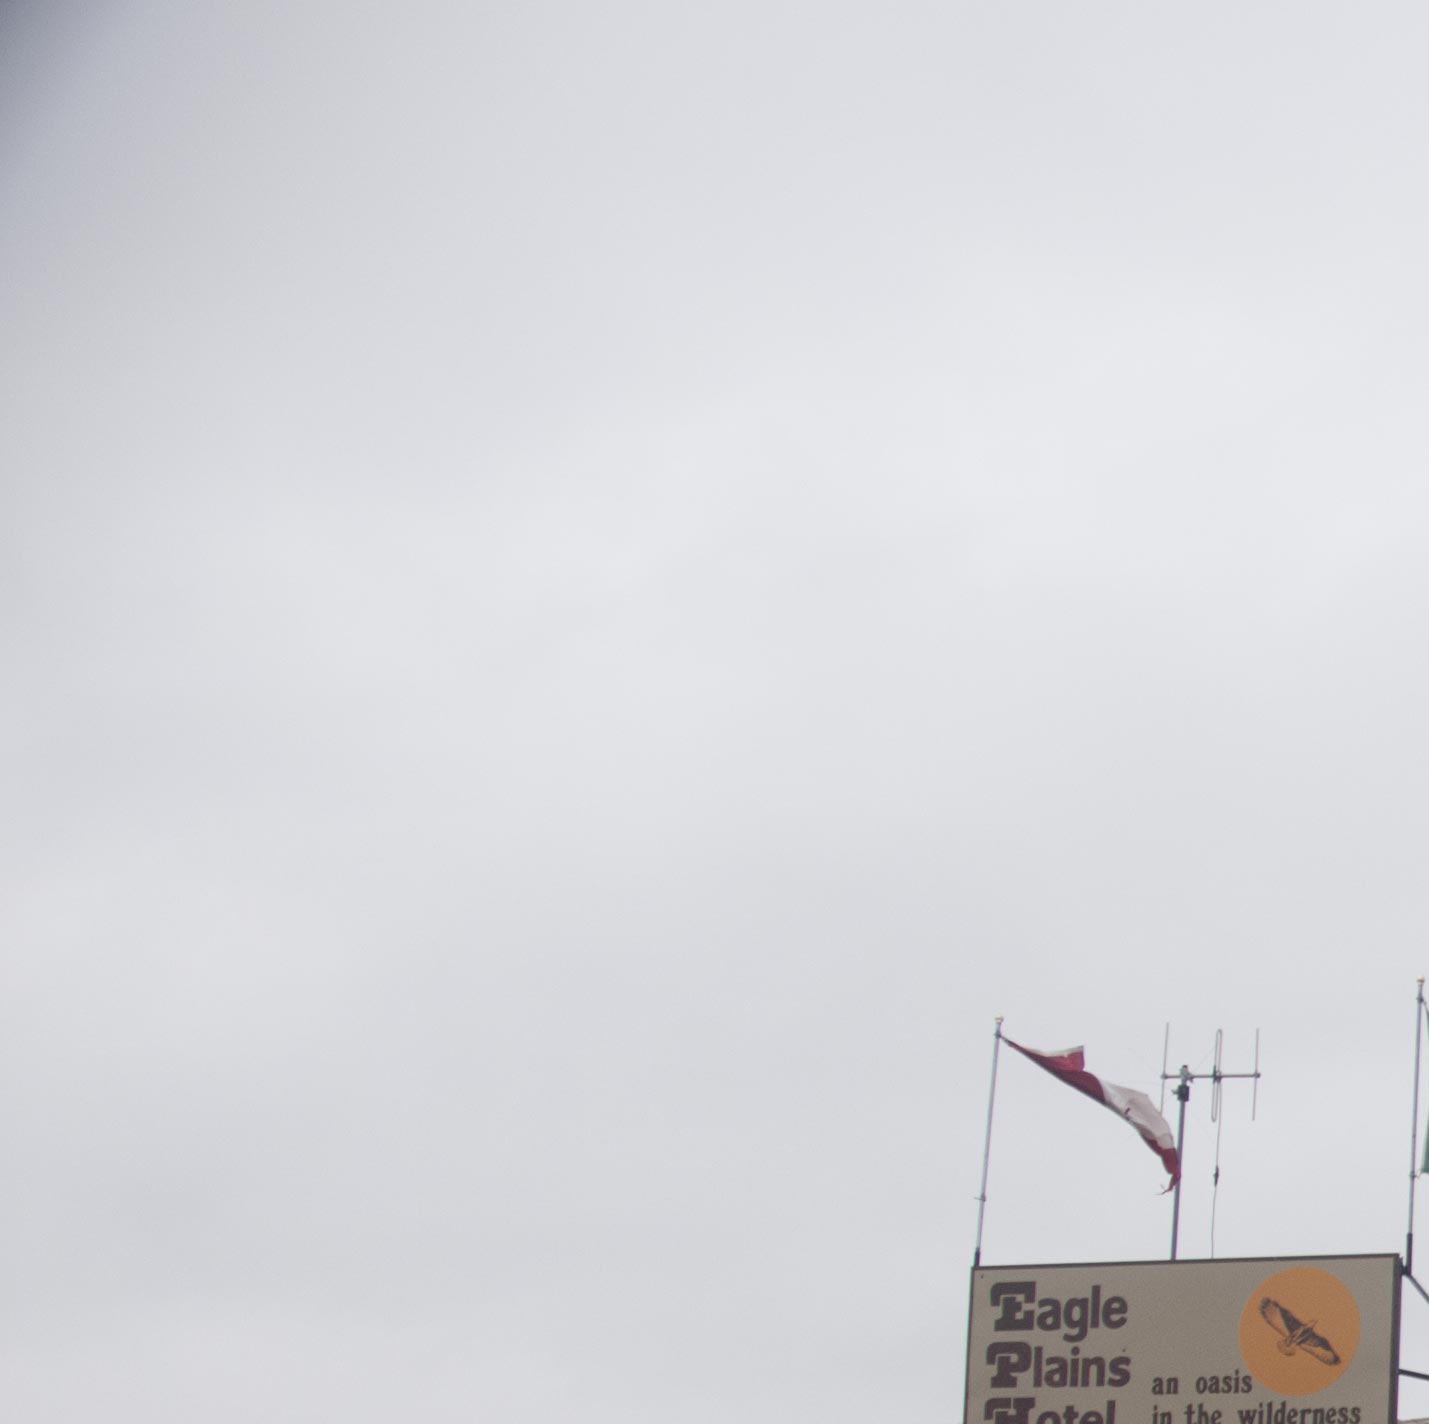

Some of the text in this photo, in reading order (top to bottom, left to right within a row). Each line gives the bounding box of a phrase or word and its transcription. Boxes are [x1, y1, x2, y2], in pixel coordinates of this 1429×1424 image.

[990, 1281, 1129, 1342] Eagle
[986, 1340, 1131, 1389] Plains
[1151, 1370, 1252, 1395] an oasis
